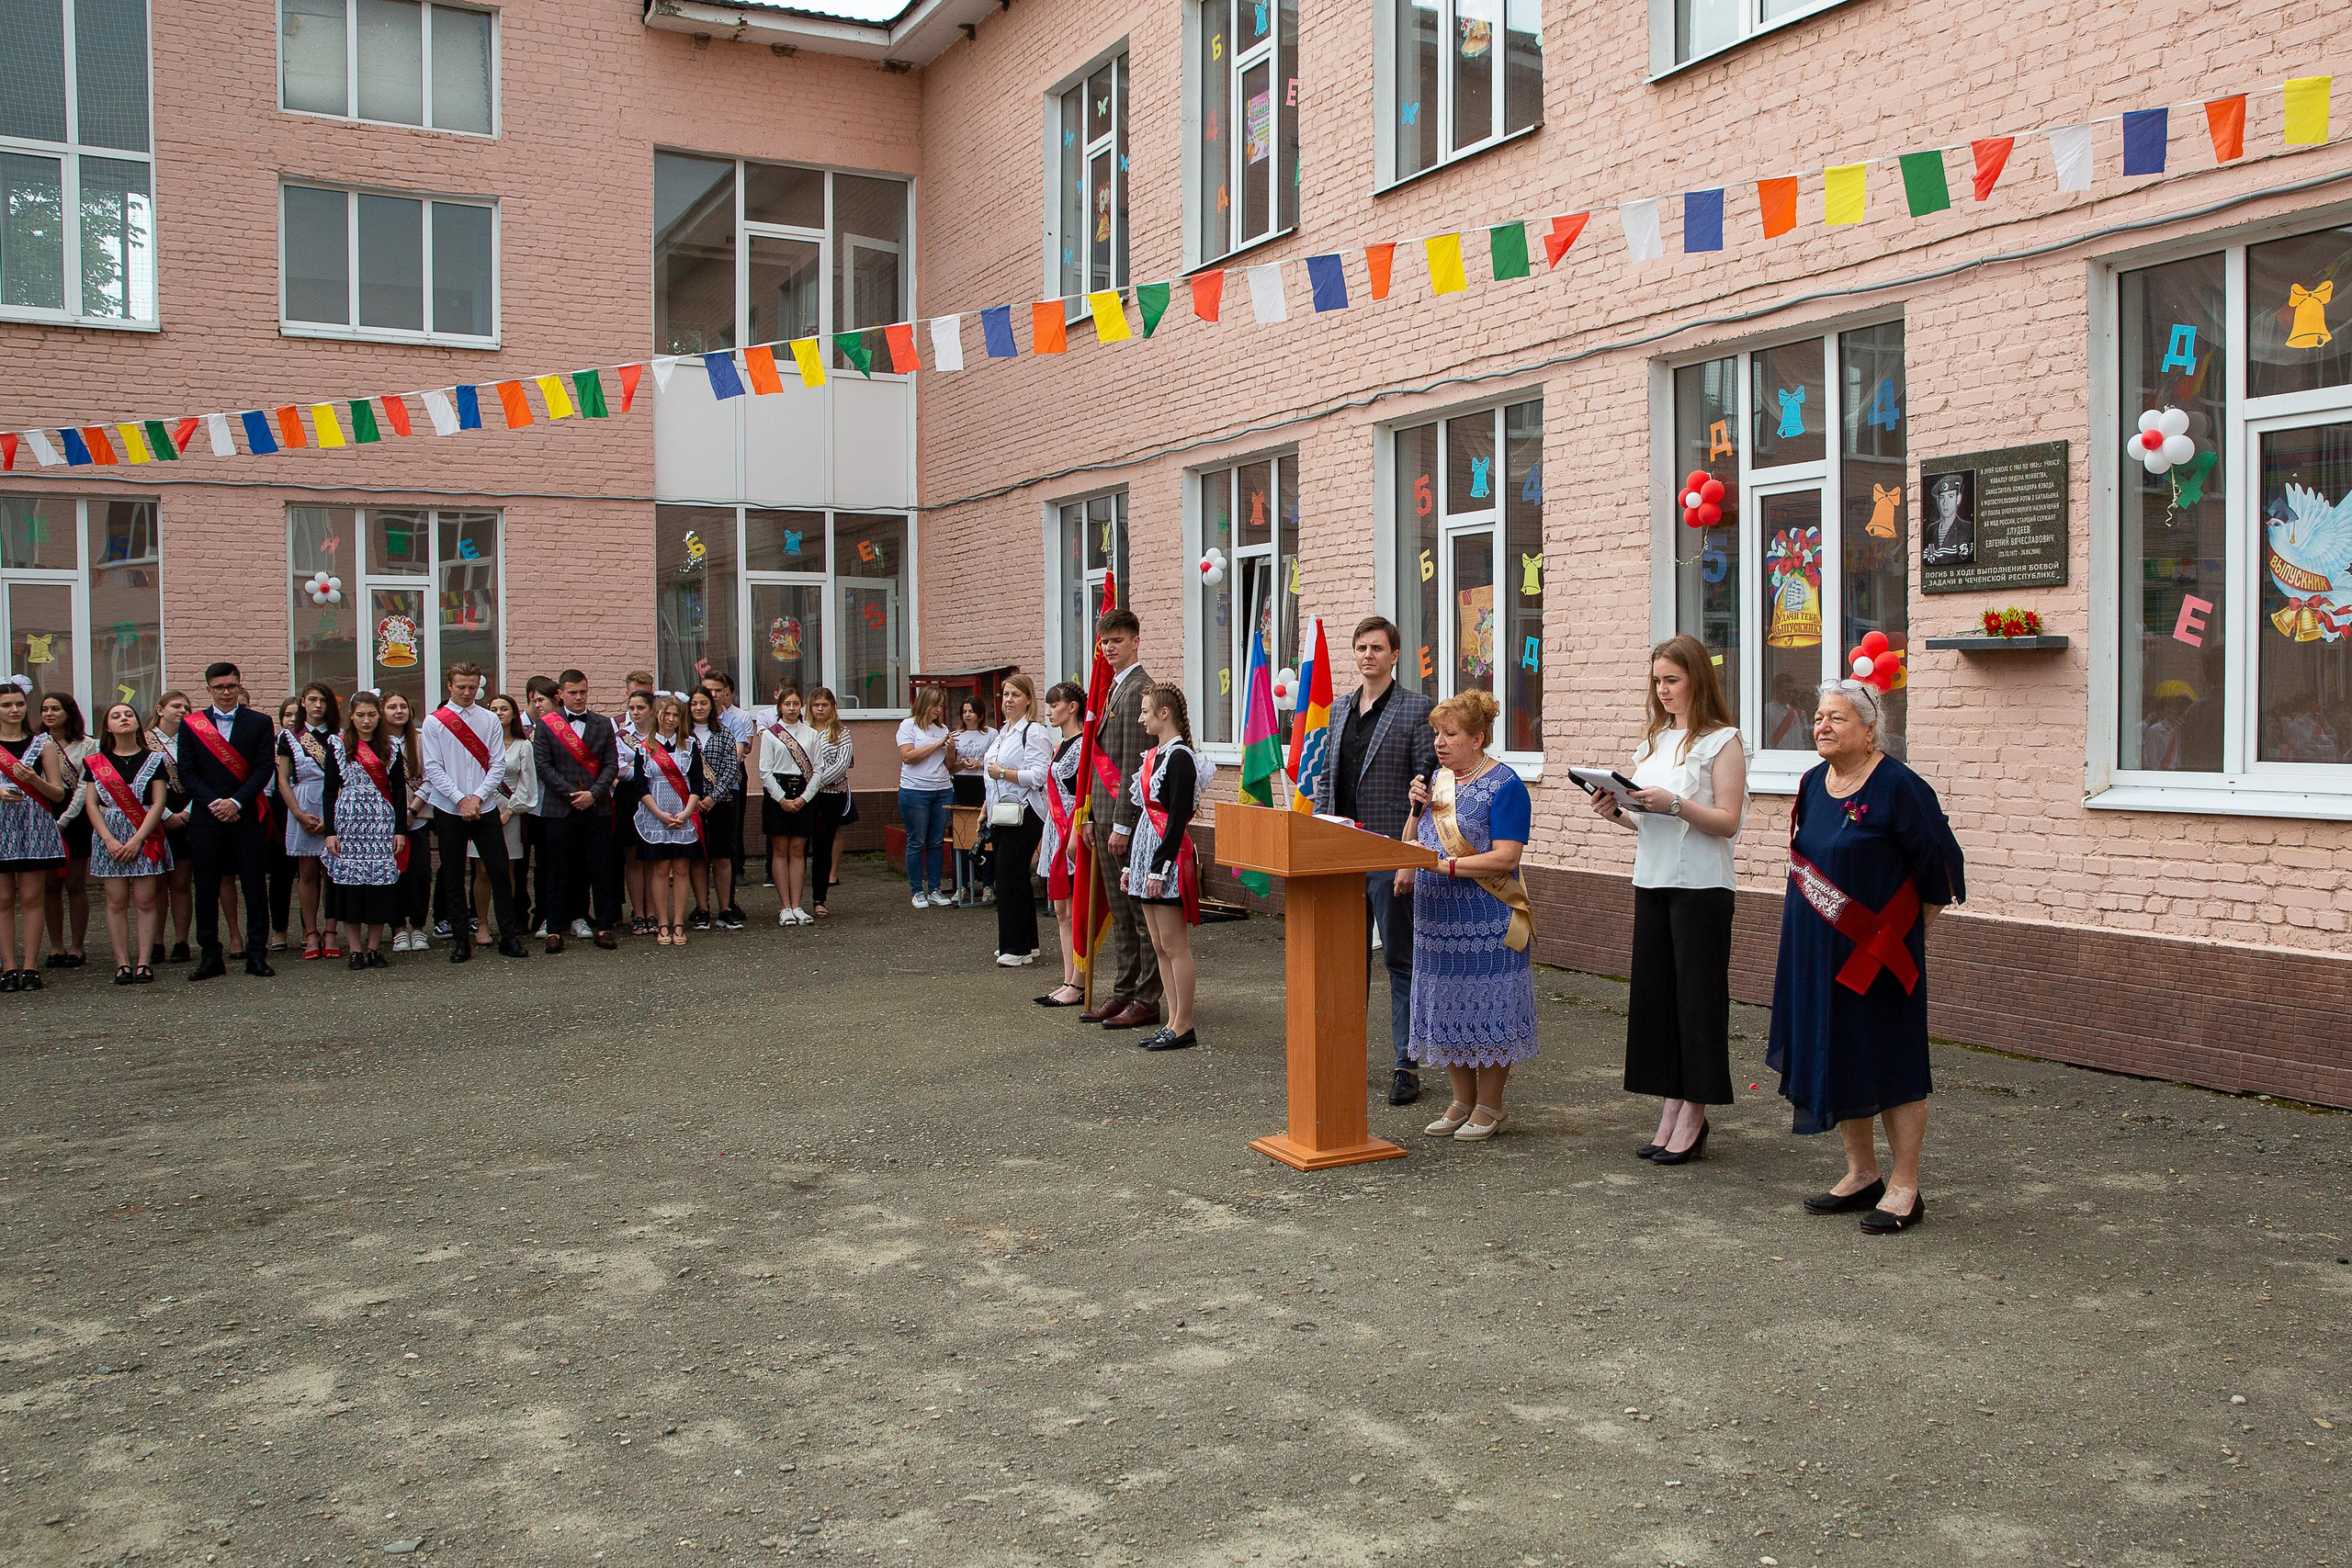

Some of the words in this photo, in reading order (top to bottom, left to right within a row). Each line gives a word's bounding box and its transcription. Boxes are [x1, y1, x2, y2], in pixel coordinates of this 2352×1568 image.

[1211, 33, 1222, 62] Б
[2161, 323, 2197, 375] Д
[1868, 378, 1900, 432] 4
[1710, 419, 1734, 463] Д
[1521, 464, 1543, 505] 4
[1985, 487, 2012, 496] ЗАМЕСТИТЕЛЬ
[2012, 483, 2038, 493] КОМАНДИРА
[2164, 450, 2218, 510] 4
[1414, 473, 1432, 517] 5
[2006, 525, 2031, 536] ХЛУДЕЕВ
[2017, 514, 2036, 525] СТАРШИЙ
[2037, 513, 2056, 522] СЕРЖАНТ
[457, 536, 481, 561] Е
[685, 536, 707, 558] Б
[856, 540, 876, 562] Е
[1985, 536, 2009, 548] ЕВГЕНИЙ
[2010, 534, 2054, 546] ВЯЧЕСЛАВОВИЧ
[1418, 548, 1434, 583] Б
[1702, 536, 1727, 582] 5
[1956, 569, 1975, 577] ХОДЕ
[1976, 565, 2027, 575] ВЫПОЛНЕНИЯ
[2029, 561, 2060, 571] БОЕВОЙ
[2269, 554, 2328, 592] ВЫПУСКНИК
[1928, 579, 1956, 587] ЗАДАЧИ
[1964, 574, 2006, 584] ЧЕЧЕНСКОЙ
[2008, 570, 2055, 581] РЕСПУБЛИКЕ
[862, 602, 886, 630] 5
[1771, 622, 1822, 636] ВЫПУСКНИК!
[1775, 610, 1799, 624] УДАЧИ
[2172, 593, 2213, 649] Е
[1417, 645, 1433, 679] Е
[1521, 635, 1540, 673] Д
[1218, 668, 1230, 696] В
